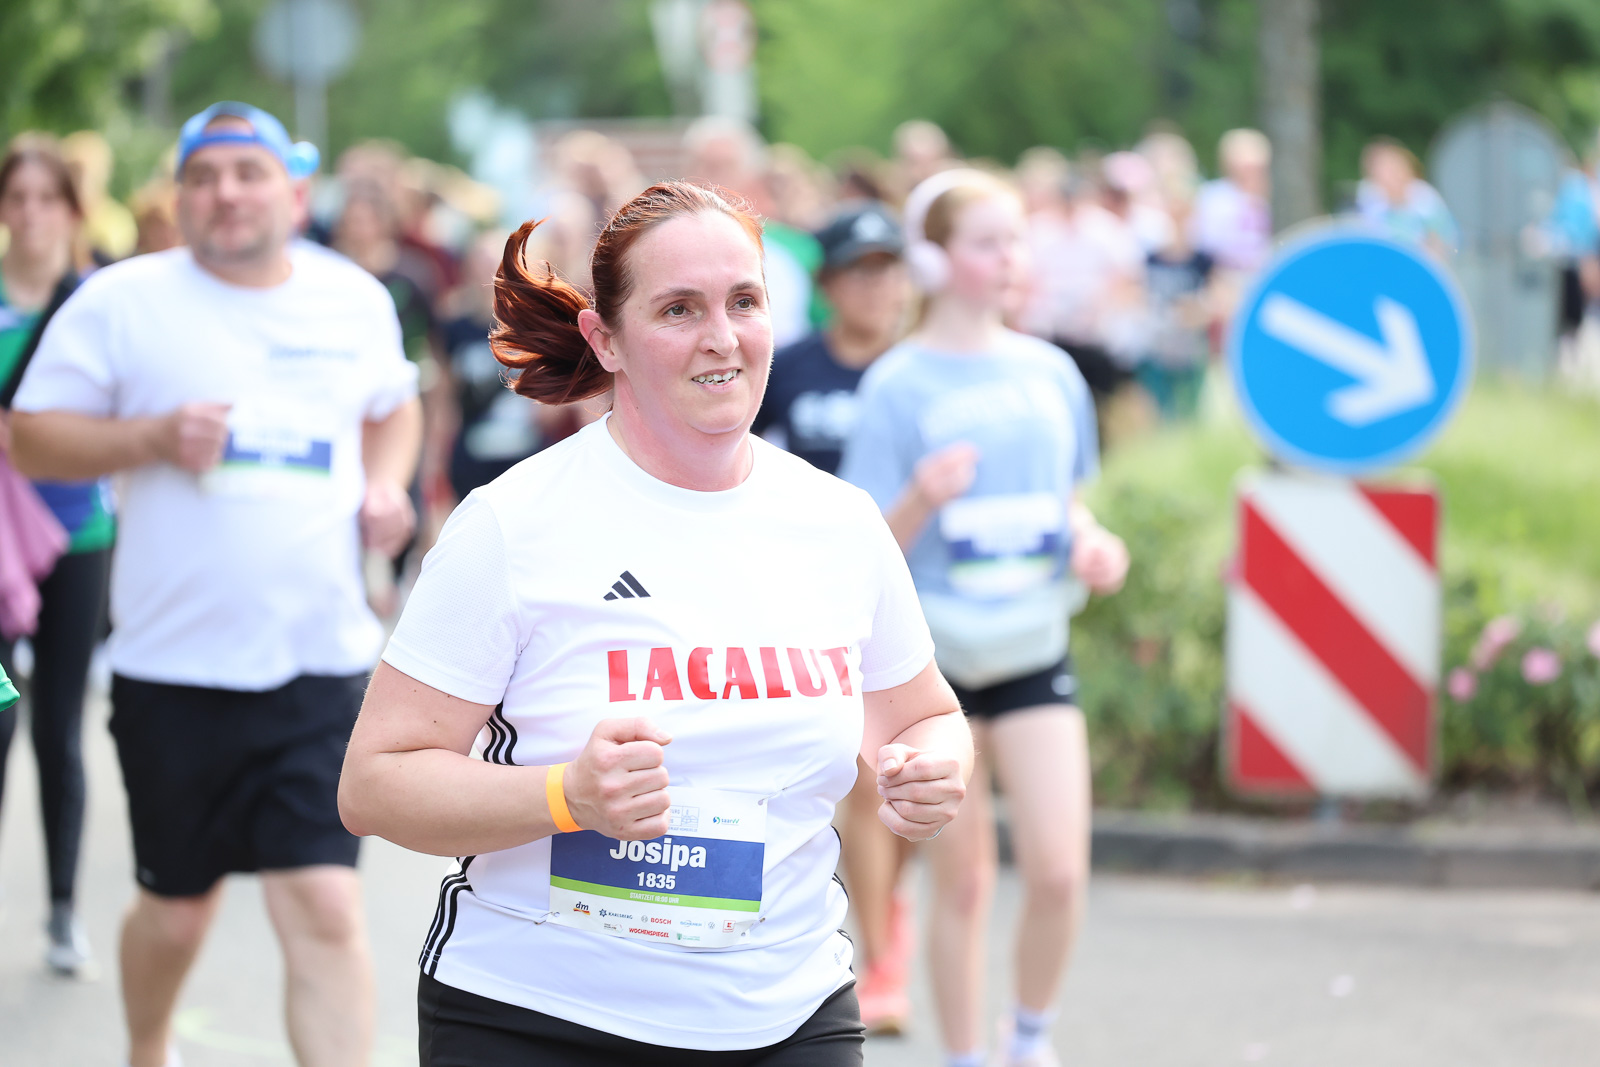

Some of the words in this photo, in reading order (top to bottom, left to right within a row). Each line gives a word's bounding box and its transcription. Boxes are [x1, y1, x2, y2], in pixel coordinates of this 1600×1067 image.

[607, 646, 853, 703] LACALUT
[609, 837, 707, 872] Josipa
[637, 871, 676, 890] 1835
[629, 892, 655, 902] STARTZEIT
[668, 896, 680, 904] UHR
[575, 901, 589, 911] dm
[608, 911, 633, 920] KARLSBERG
[650, 917, 672, 925] BOSCH
[628, 927, 669, 938] WOCHENSPIEGEL
